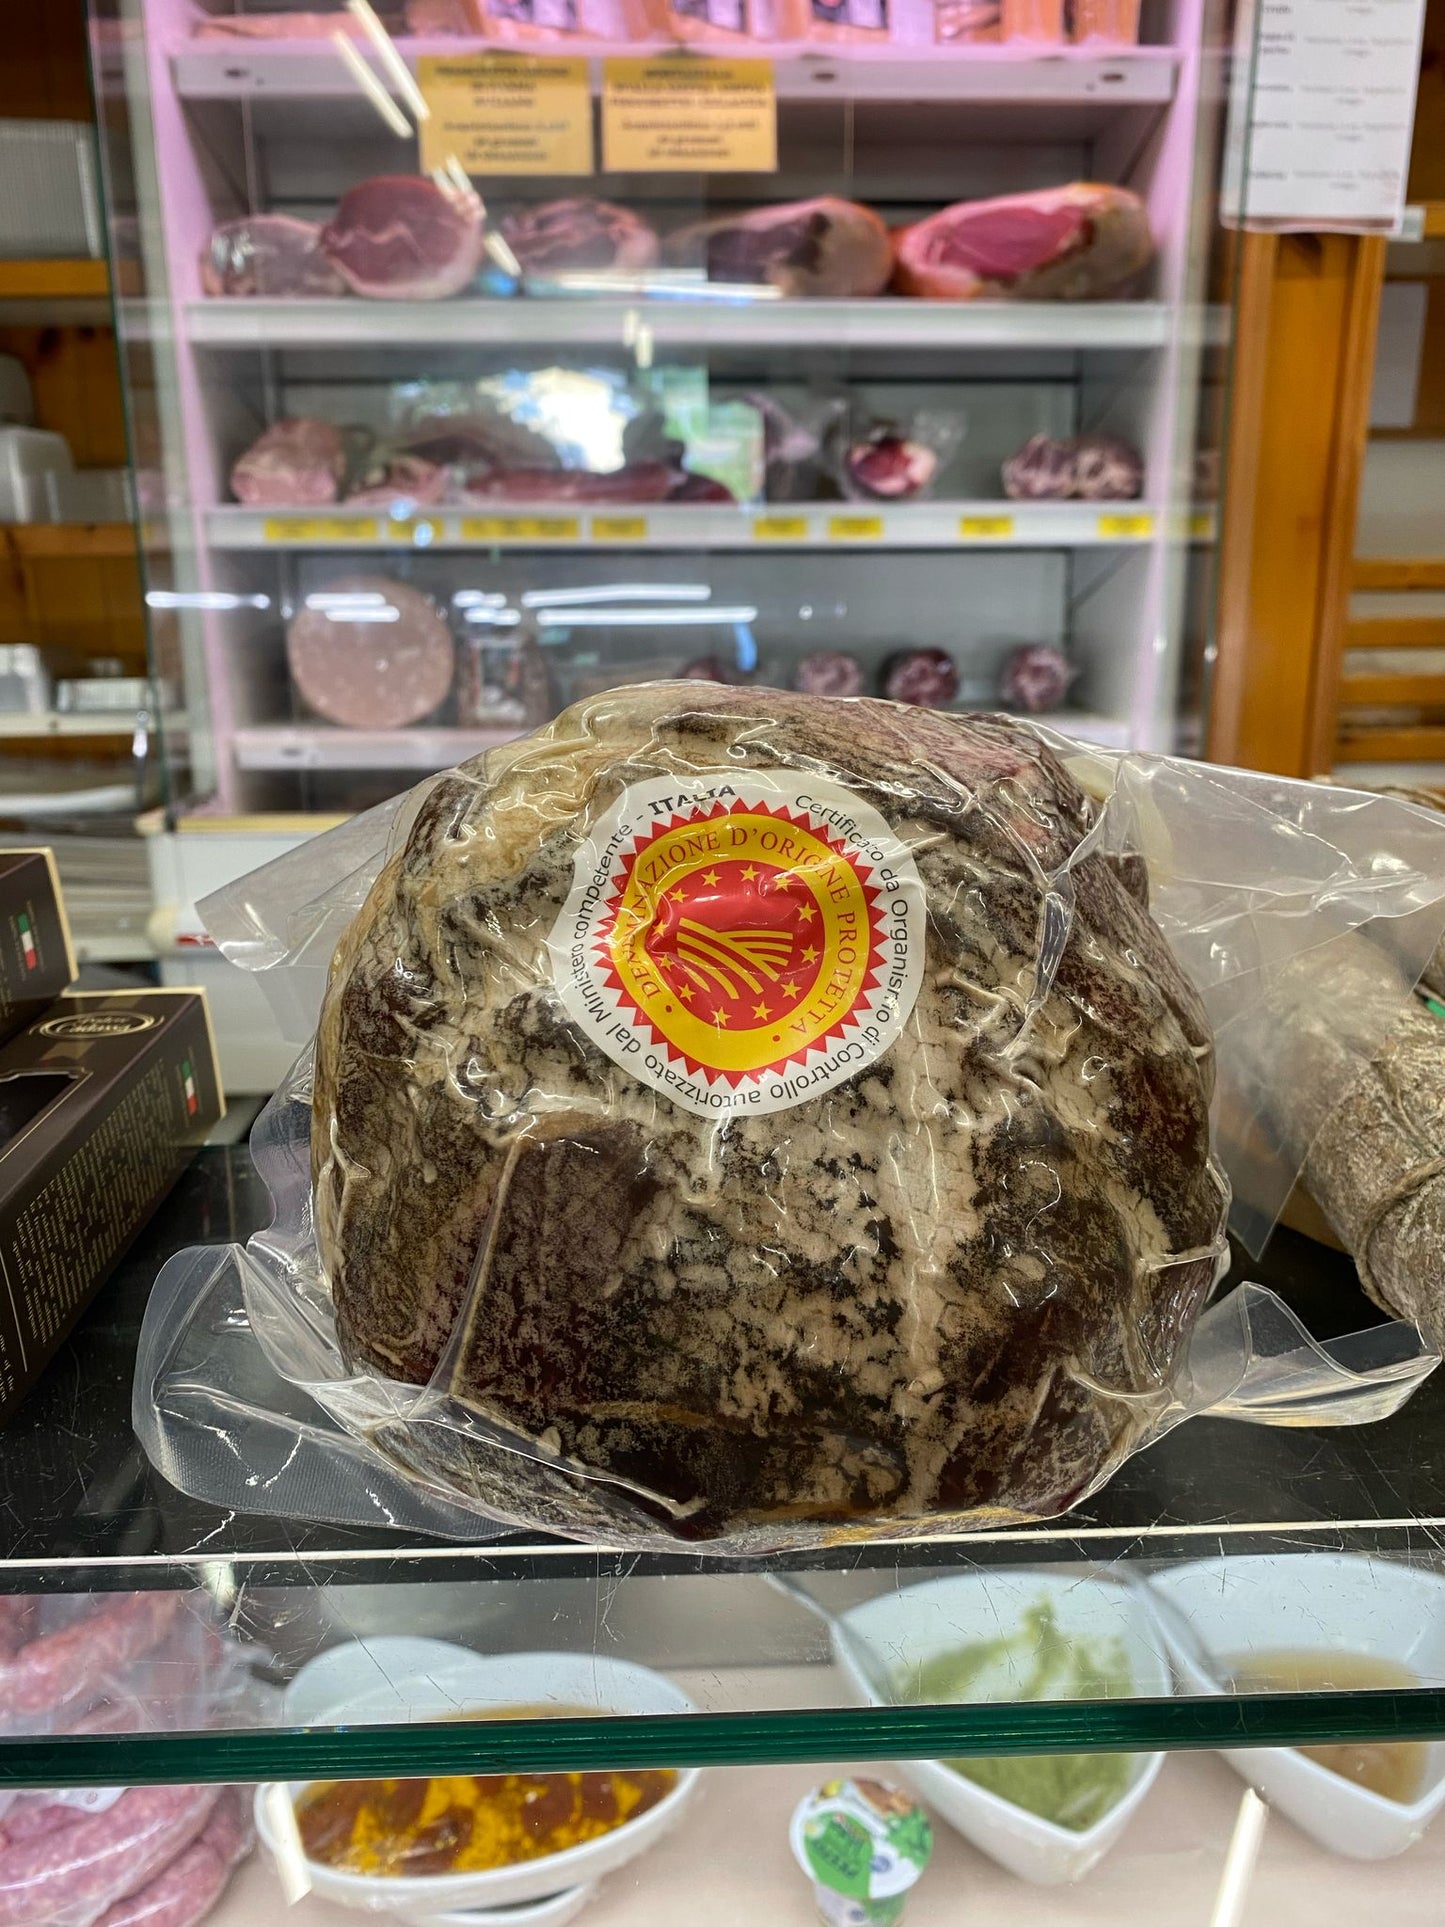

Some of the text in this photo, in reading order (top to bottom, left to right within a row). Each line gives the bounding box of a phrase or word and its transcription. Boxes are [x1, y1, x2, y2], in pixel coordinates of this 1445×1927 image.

[647, 784, 736, 816] ITALIA
[574, 824, 633, 940] competente
[731, 827, 851, 904] D'ORIGNE
[880, 868, 900, 892] da
[570, 943, 612, 1023] Ministero
[790, 911, 858, 1033] PROTETTA
[876, 899, 909, 1023] Organismo
[605, 1023, 642, 1053] dal
[861, 1026, 881, 1046] di
[645, 1054, 761, 1108] autorizzato
[770, 1041, 865, 1100] Controllo
